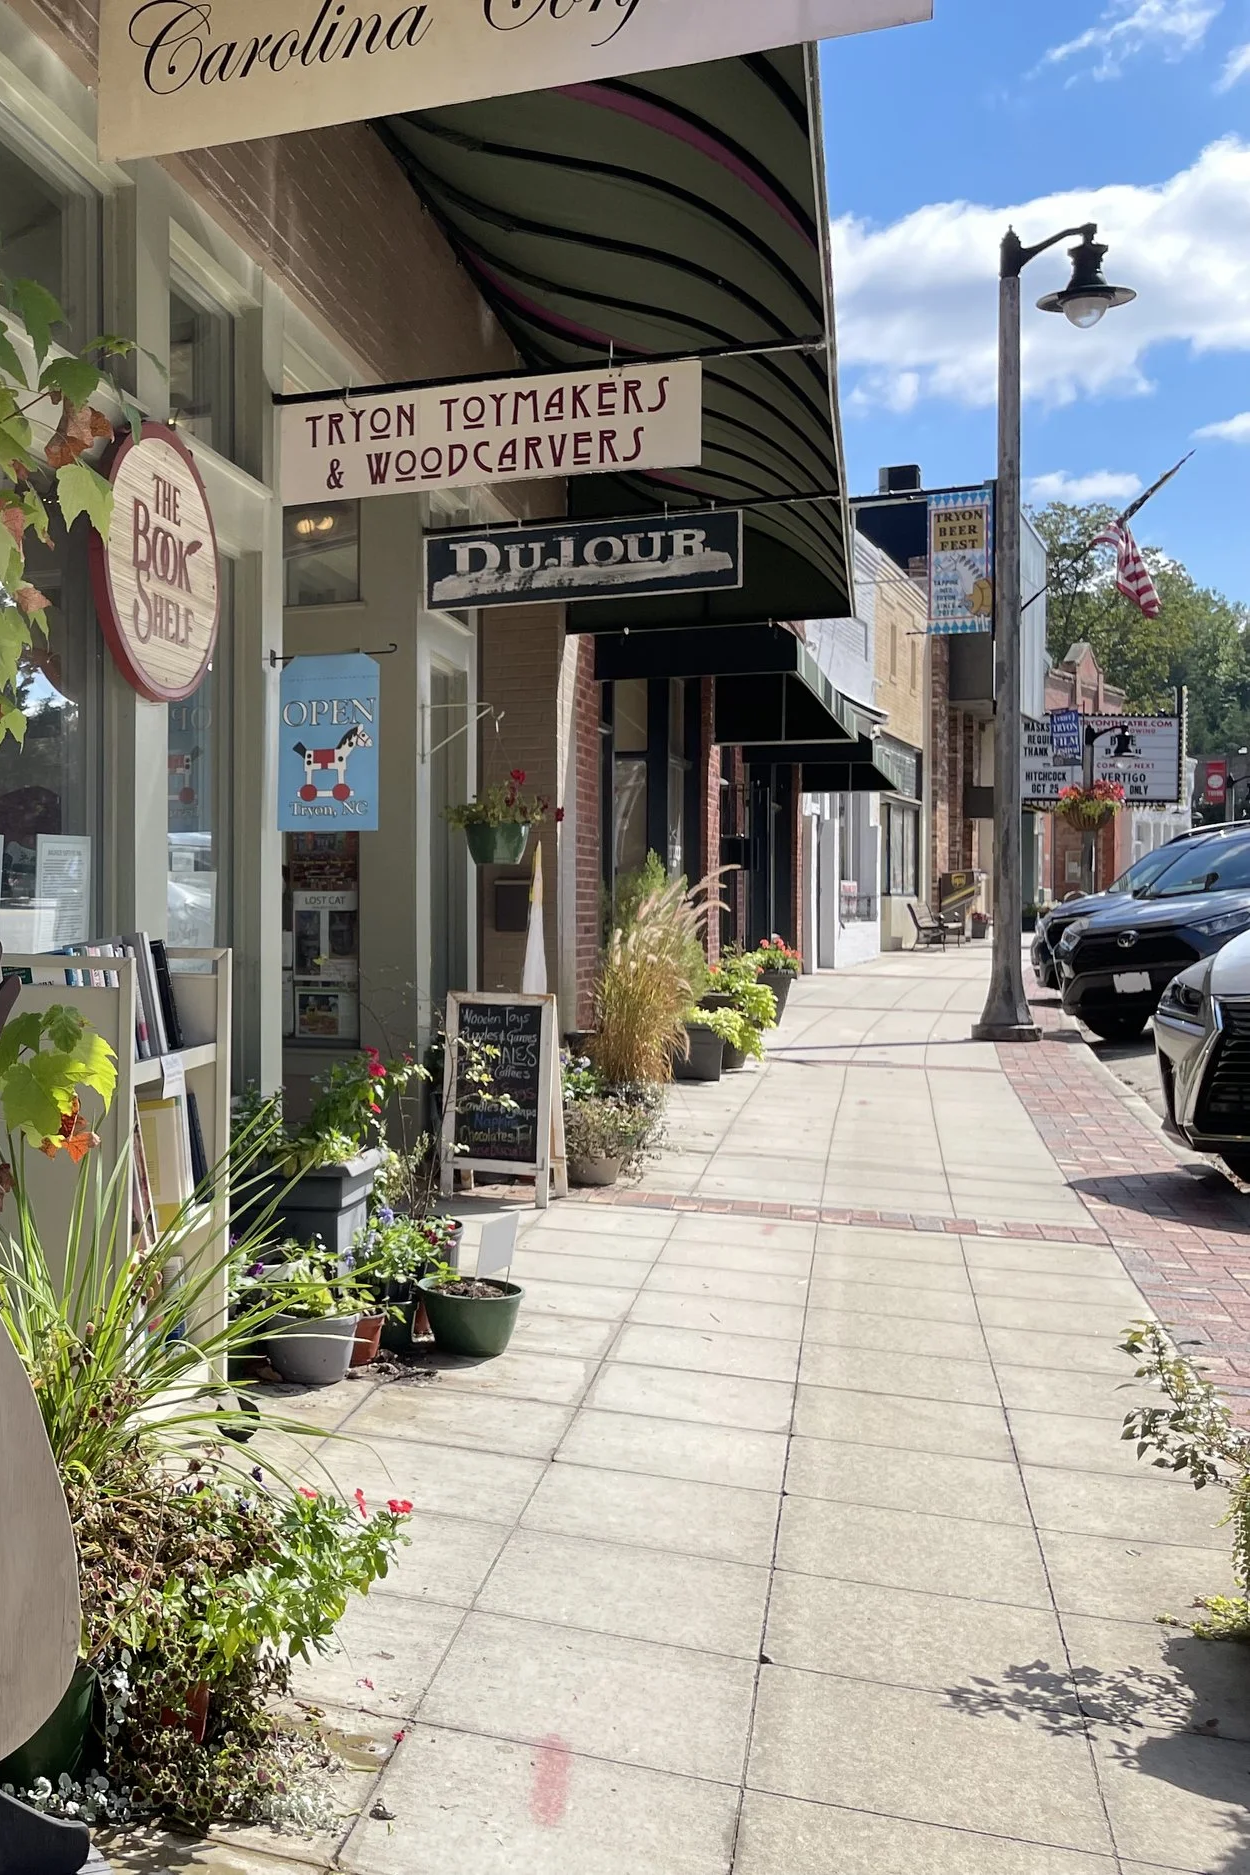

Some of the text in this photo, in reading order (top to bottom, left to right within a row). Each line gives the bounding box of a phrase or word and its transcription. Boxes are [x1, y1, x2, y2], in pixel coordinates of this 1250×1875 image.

[128, 0, 433, 96] Carolina
[305, 376, 670, 448] TRYON TOYMAKERS
[326, 426, 646, 490] & WOODCARVERS
[152, 473, 182, 527] THE
[934, 509, 983, 524] TRYON
[938, 525, 978, 537] BEER
[132, 496, 203, 594] BOOK
[939, 539, 979, 551] FEST
[133, 567, 195, 650] SHELF
[281, 697, 377, 728] OPEN
[1023, 722, 1050, 732] MASKS
[1027, 735, 1050, 745] REQUI
[1023, 747, 1049, 757] THANK
[1025, 771, 1067, 781] HITCHCOCK
[1101, 773, 1146, 783] VERTIGO
[1031, 783, 1059, 794] OCT 25
[1129, 785, 1149, 795] ONLY
[289, 800, 369, 819] Tryon, NC
[305, 896, 346, 905] LOST CAT
[461, 1006, 531, 1031] Wooden Toys
[461, 1030, 499, 1044] Puzzles
[506, 1031, 538, 1045] Games
[494, 1064, 531, 1080] Coffees
[457, 1098, 499, 1116] Candles
[459, 1125, 514, 1143] Chocolates
